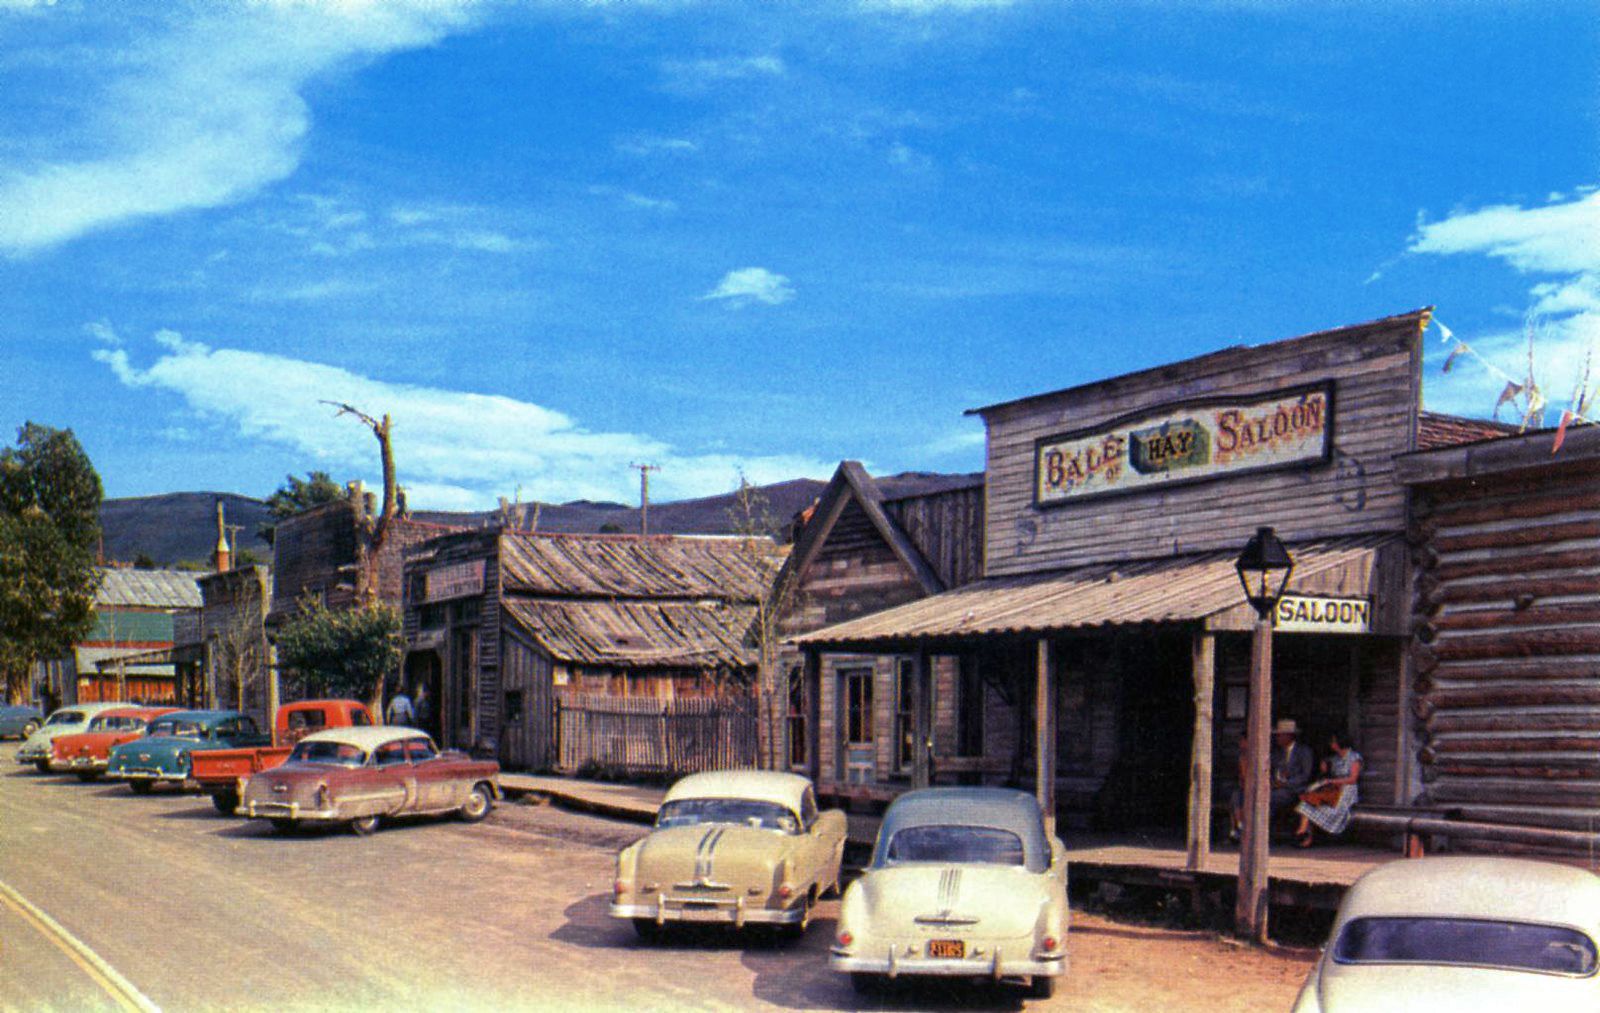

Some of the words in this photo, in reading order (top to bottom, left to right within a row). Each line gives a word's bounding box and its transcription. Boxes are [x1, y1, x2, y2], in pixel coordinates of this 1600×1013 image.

[1045, 434, 1124, 488] BALE
[1149, 430, 1193, 461] HAY
[1217, 398, 1324, 452] SALOON
[1279, 599, 1368, 623] SALOON
